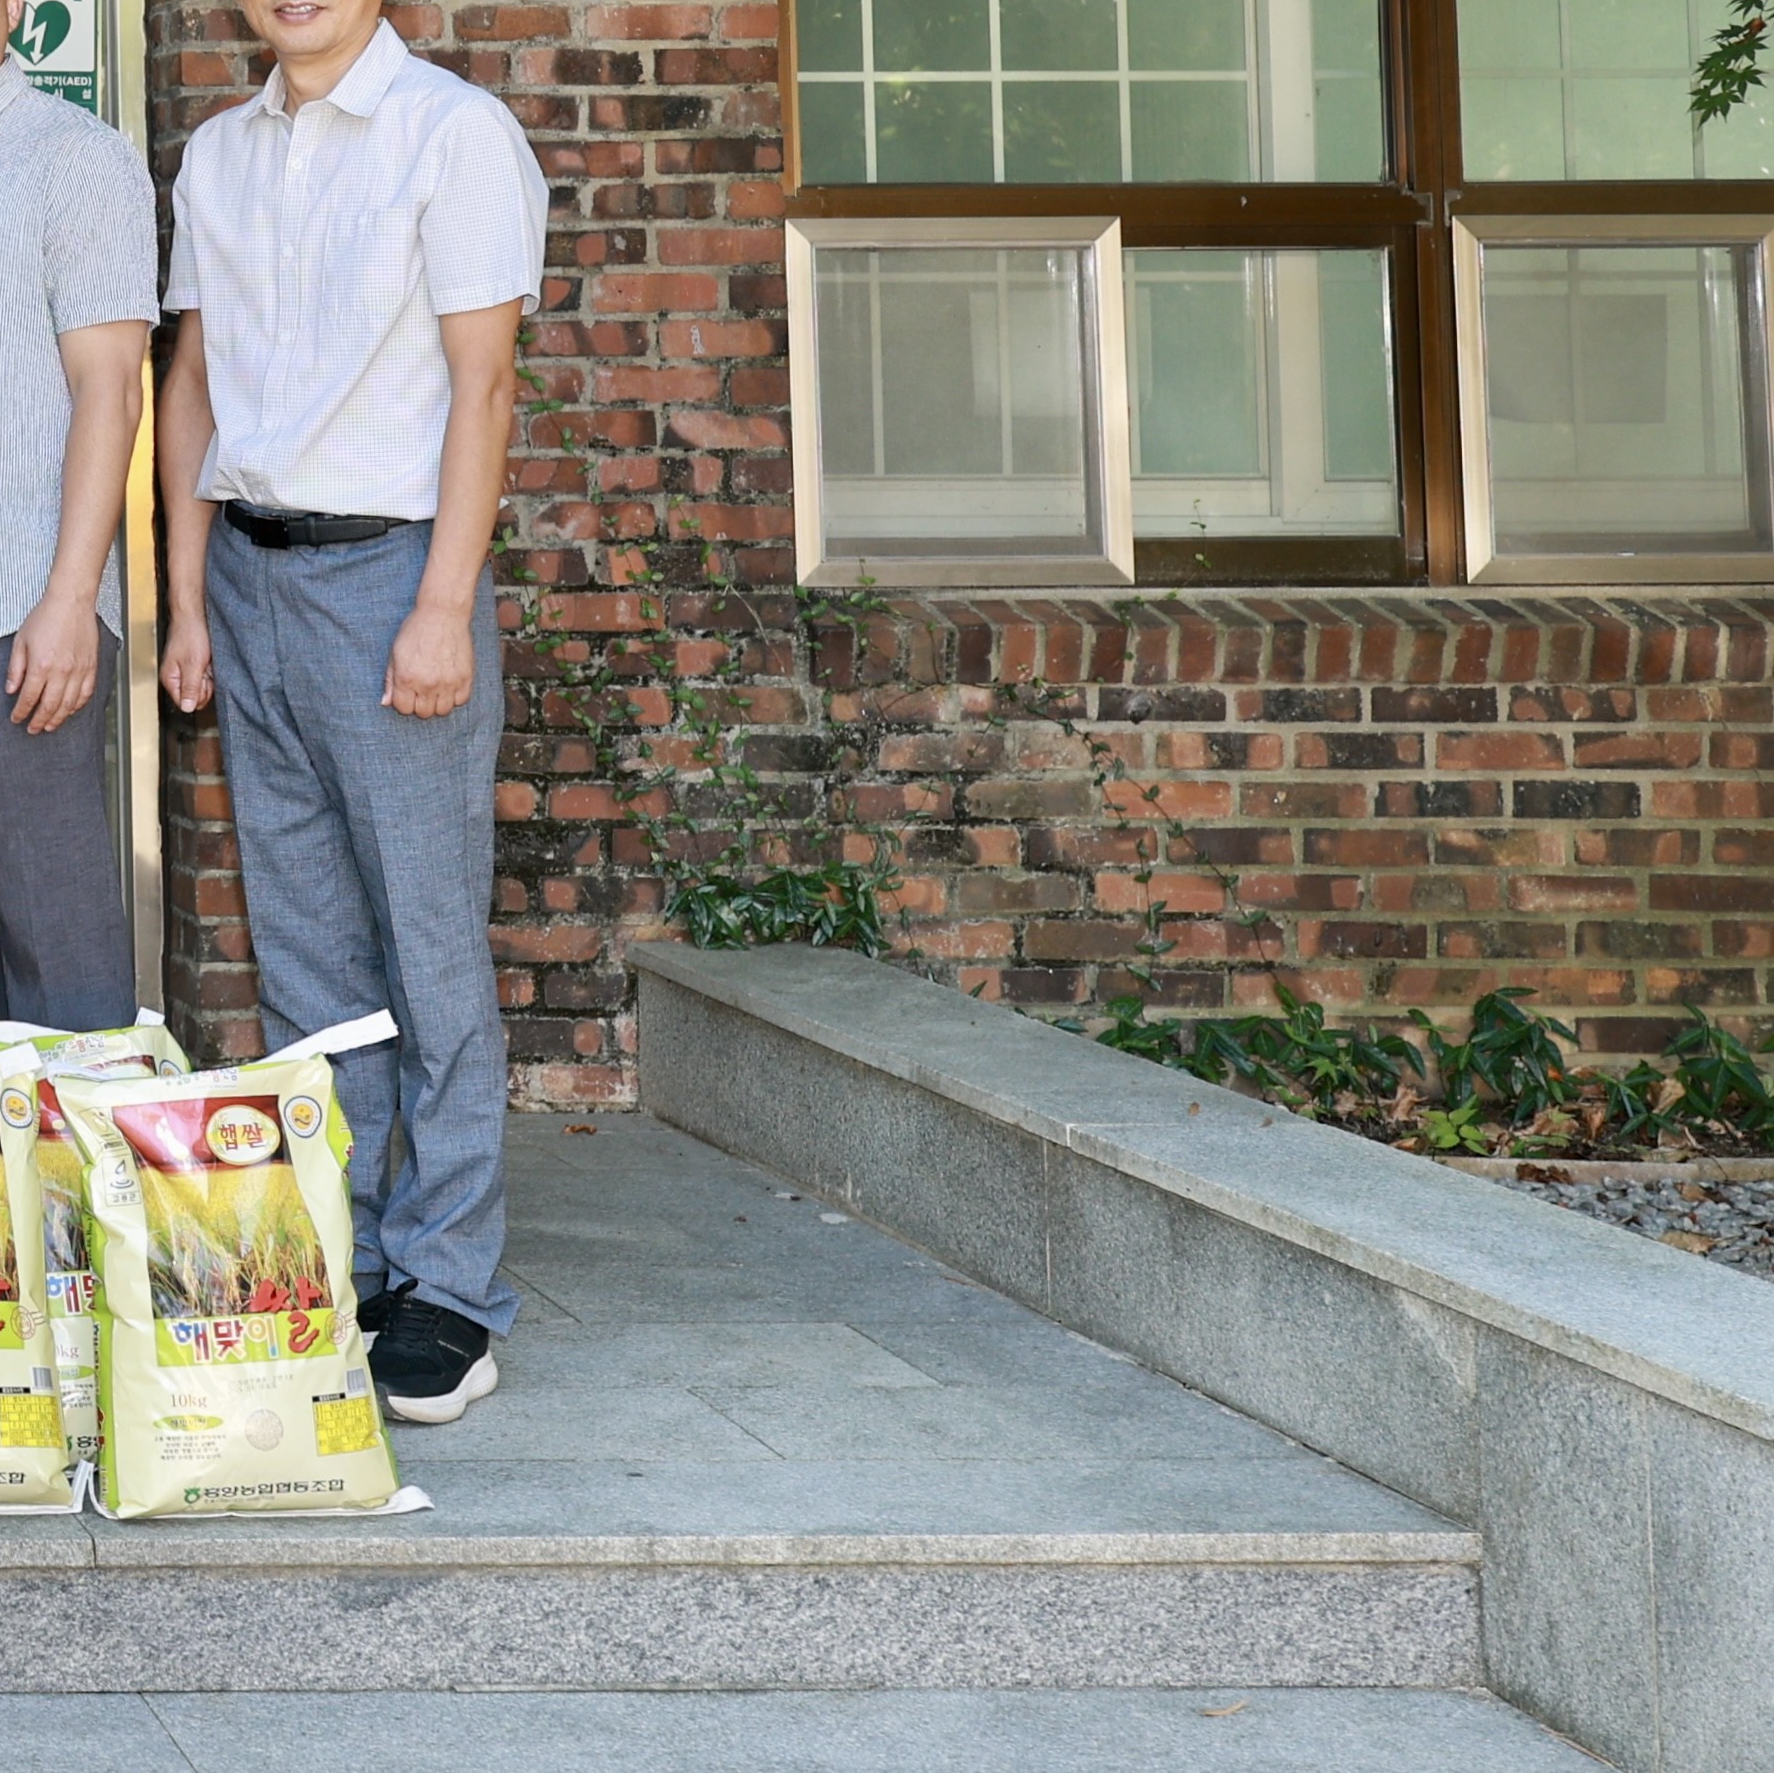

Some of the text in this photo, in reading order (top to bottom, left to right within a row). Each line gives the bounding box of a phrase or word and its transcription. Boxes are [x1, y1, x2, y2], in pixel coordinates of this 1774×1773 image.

[219, 1125, 264, 1150] 햅쌀
[172, 1276, 322, 1364] 해맞이 쌀
[169, 1393, 208, 1409] 10kg
